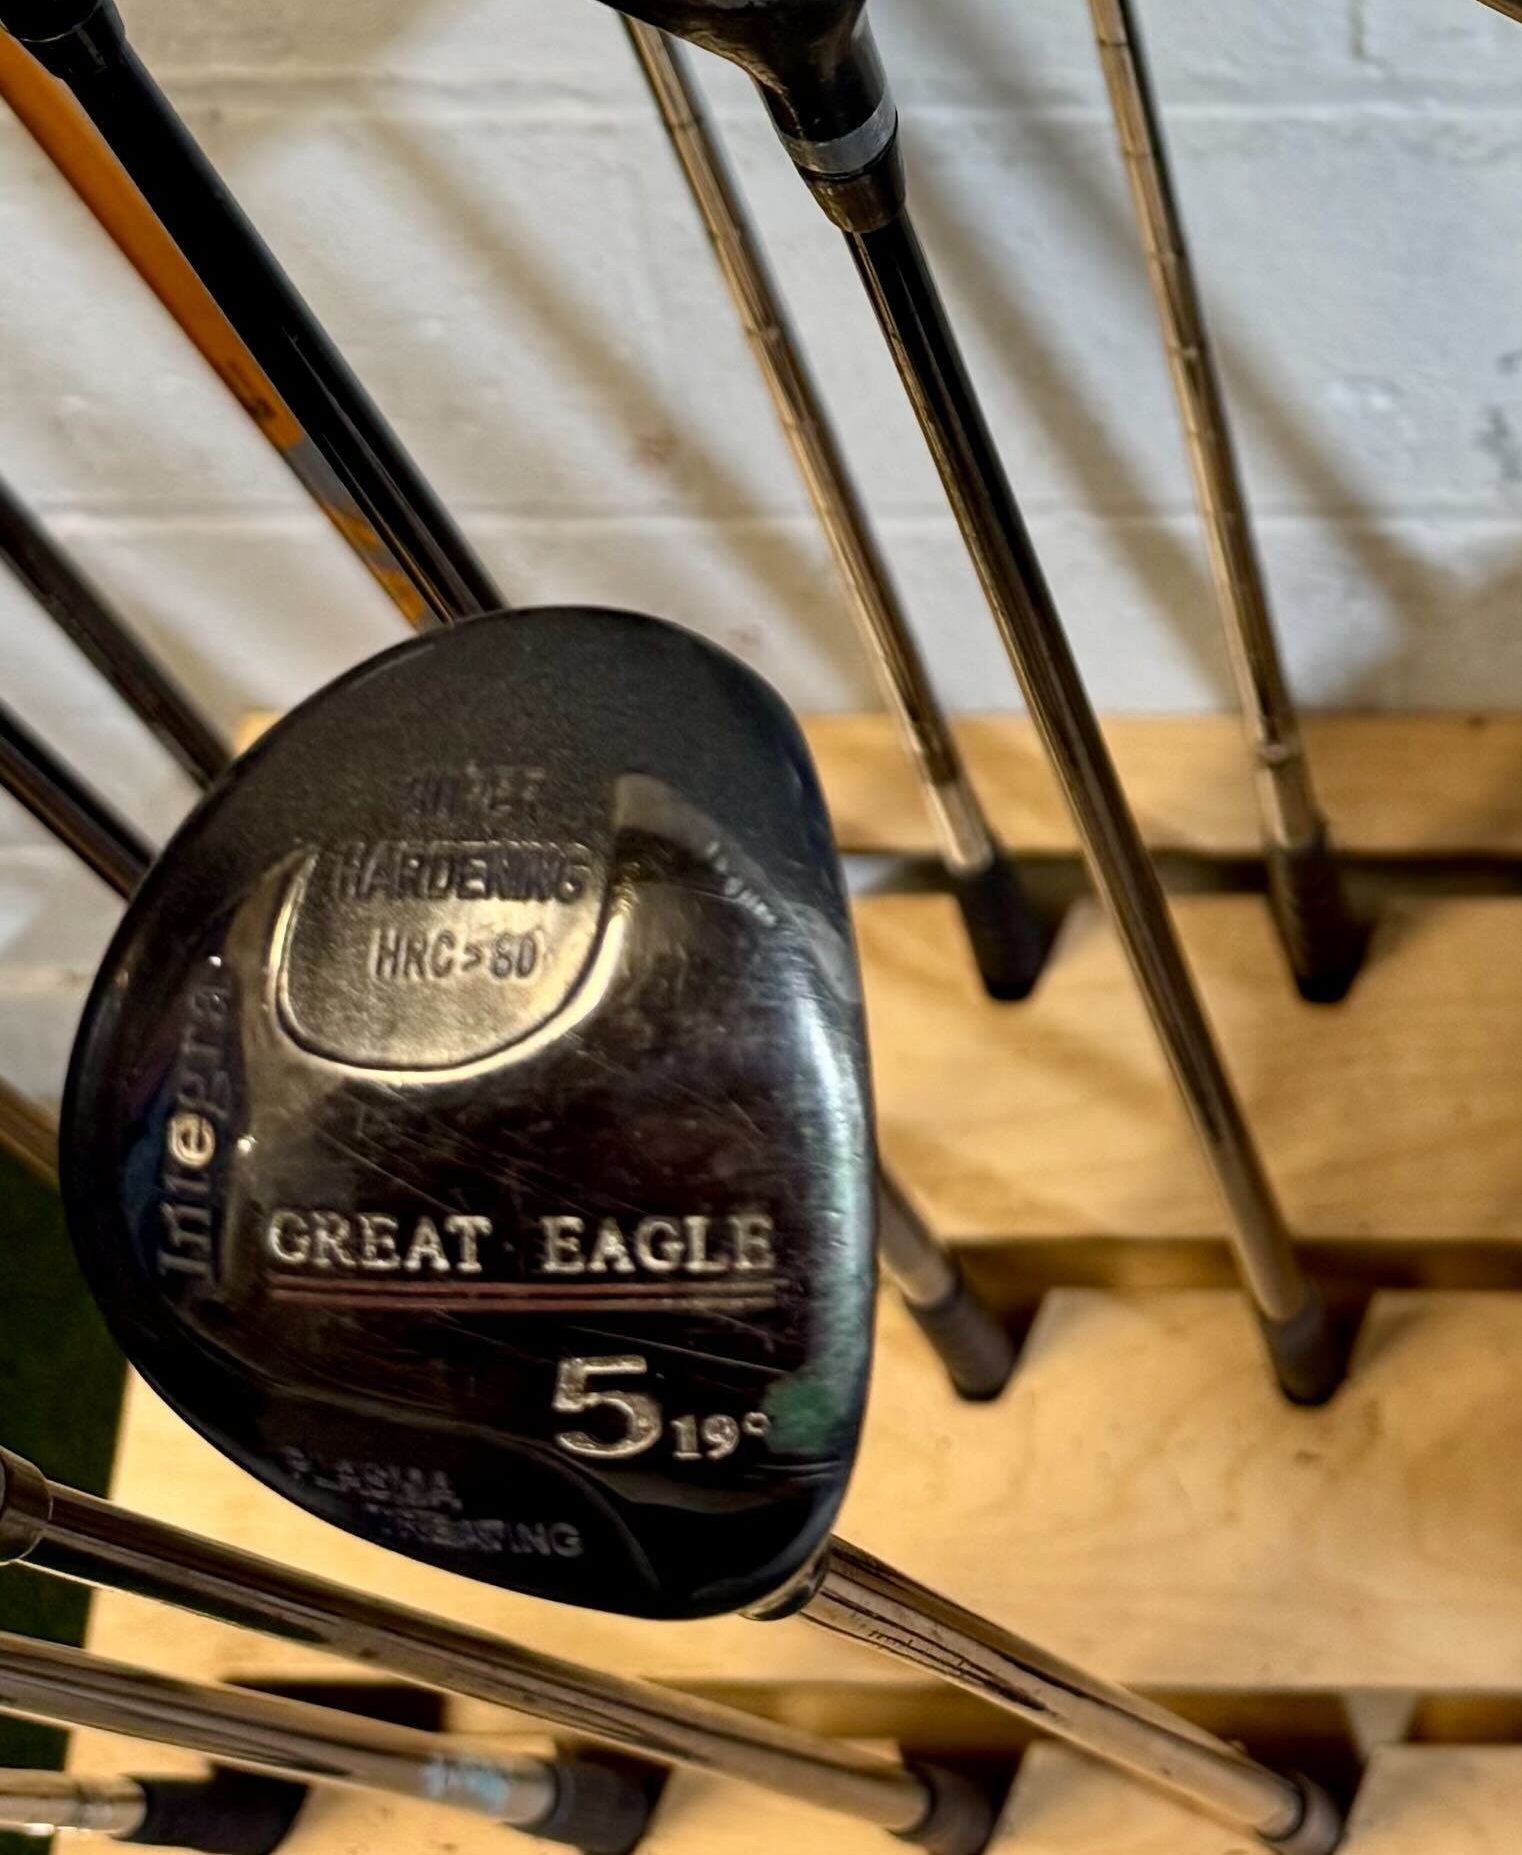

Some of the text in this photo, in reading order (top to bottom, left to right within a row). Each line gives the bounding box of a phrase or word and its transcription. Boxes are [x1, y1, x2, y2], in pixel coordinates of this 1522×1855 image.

[267, 1209, 777, 1275] GREAT EAGLE
[550, 1353, 773, 1463] 5 19°
